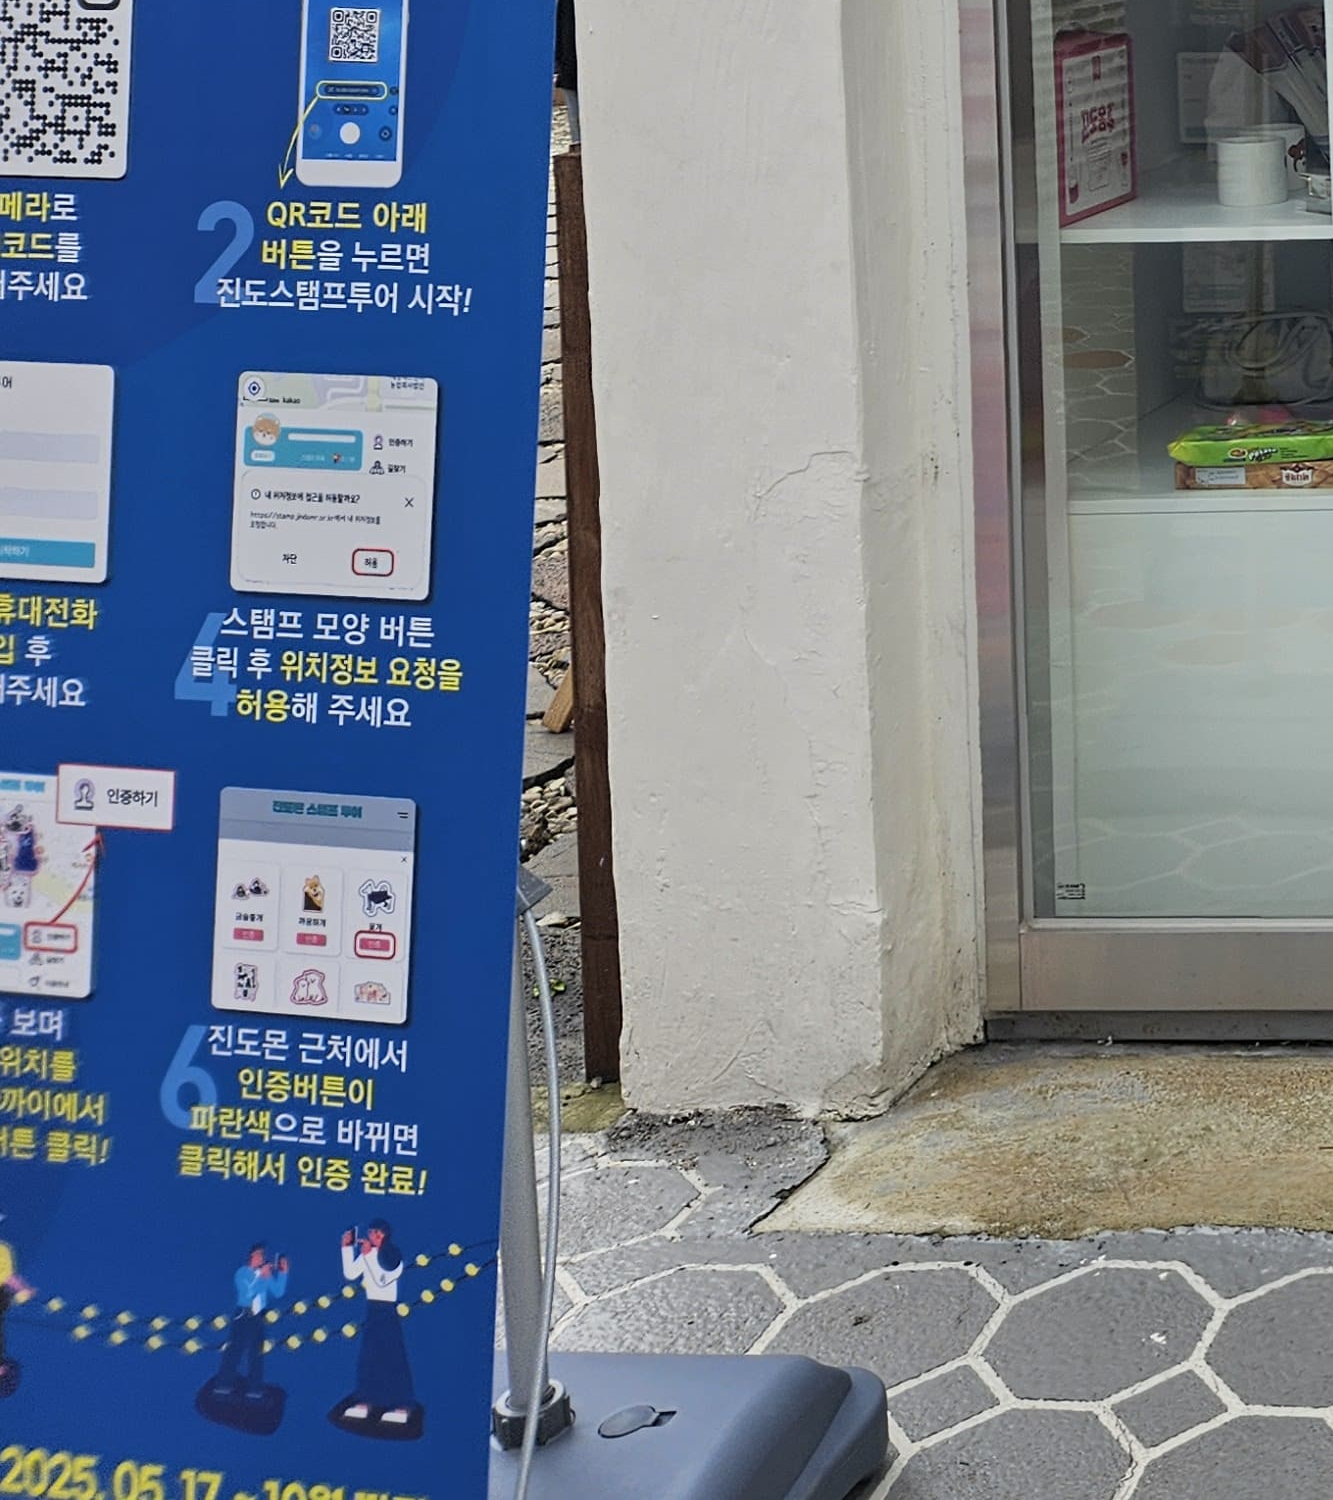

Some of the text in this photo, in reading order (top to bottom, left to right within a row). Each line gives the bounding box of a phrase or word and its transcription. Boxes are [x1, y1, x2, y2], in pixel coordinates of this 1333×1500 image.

[266, 201, 427, 234] QR코드 아래
[193, 201, 255, 304] 2
[261, 239, 430, 274] 버튼을 누르면
[0, 269, 88, 302] 주세요
[216, 278, 471, 316] 진도스탬프투어 시작!
[220, 608, 435, 648] 스탬프 모양 버튼
[25, 636, 52, 667] 후
[190, 646, 464, 692] 클릭 후 위치정보 요청을
[0, 674, 86, 708] 주세요
[235, 689, 412, 728] 허용해 주세요
[106, 787, 159, 808] 인증하기
[11, 1008, 63, 1041] 보며
[207, 1026, 408, 1072] 진도몬 근처에서
[237, 1067, 374, 1110] 인증버튼이
[47, 1130, 111, 1166] 클릭!
[189, 1105, 418, 1156] 파란색으로 바뀌면
[178, 1144, 430, 1196] 클릭해서 인증 완료!
